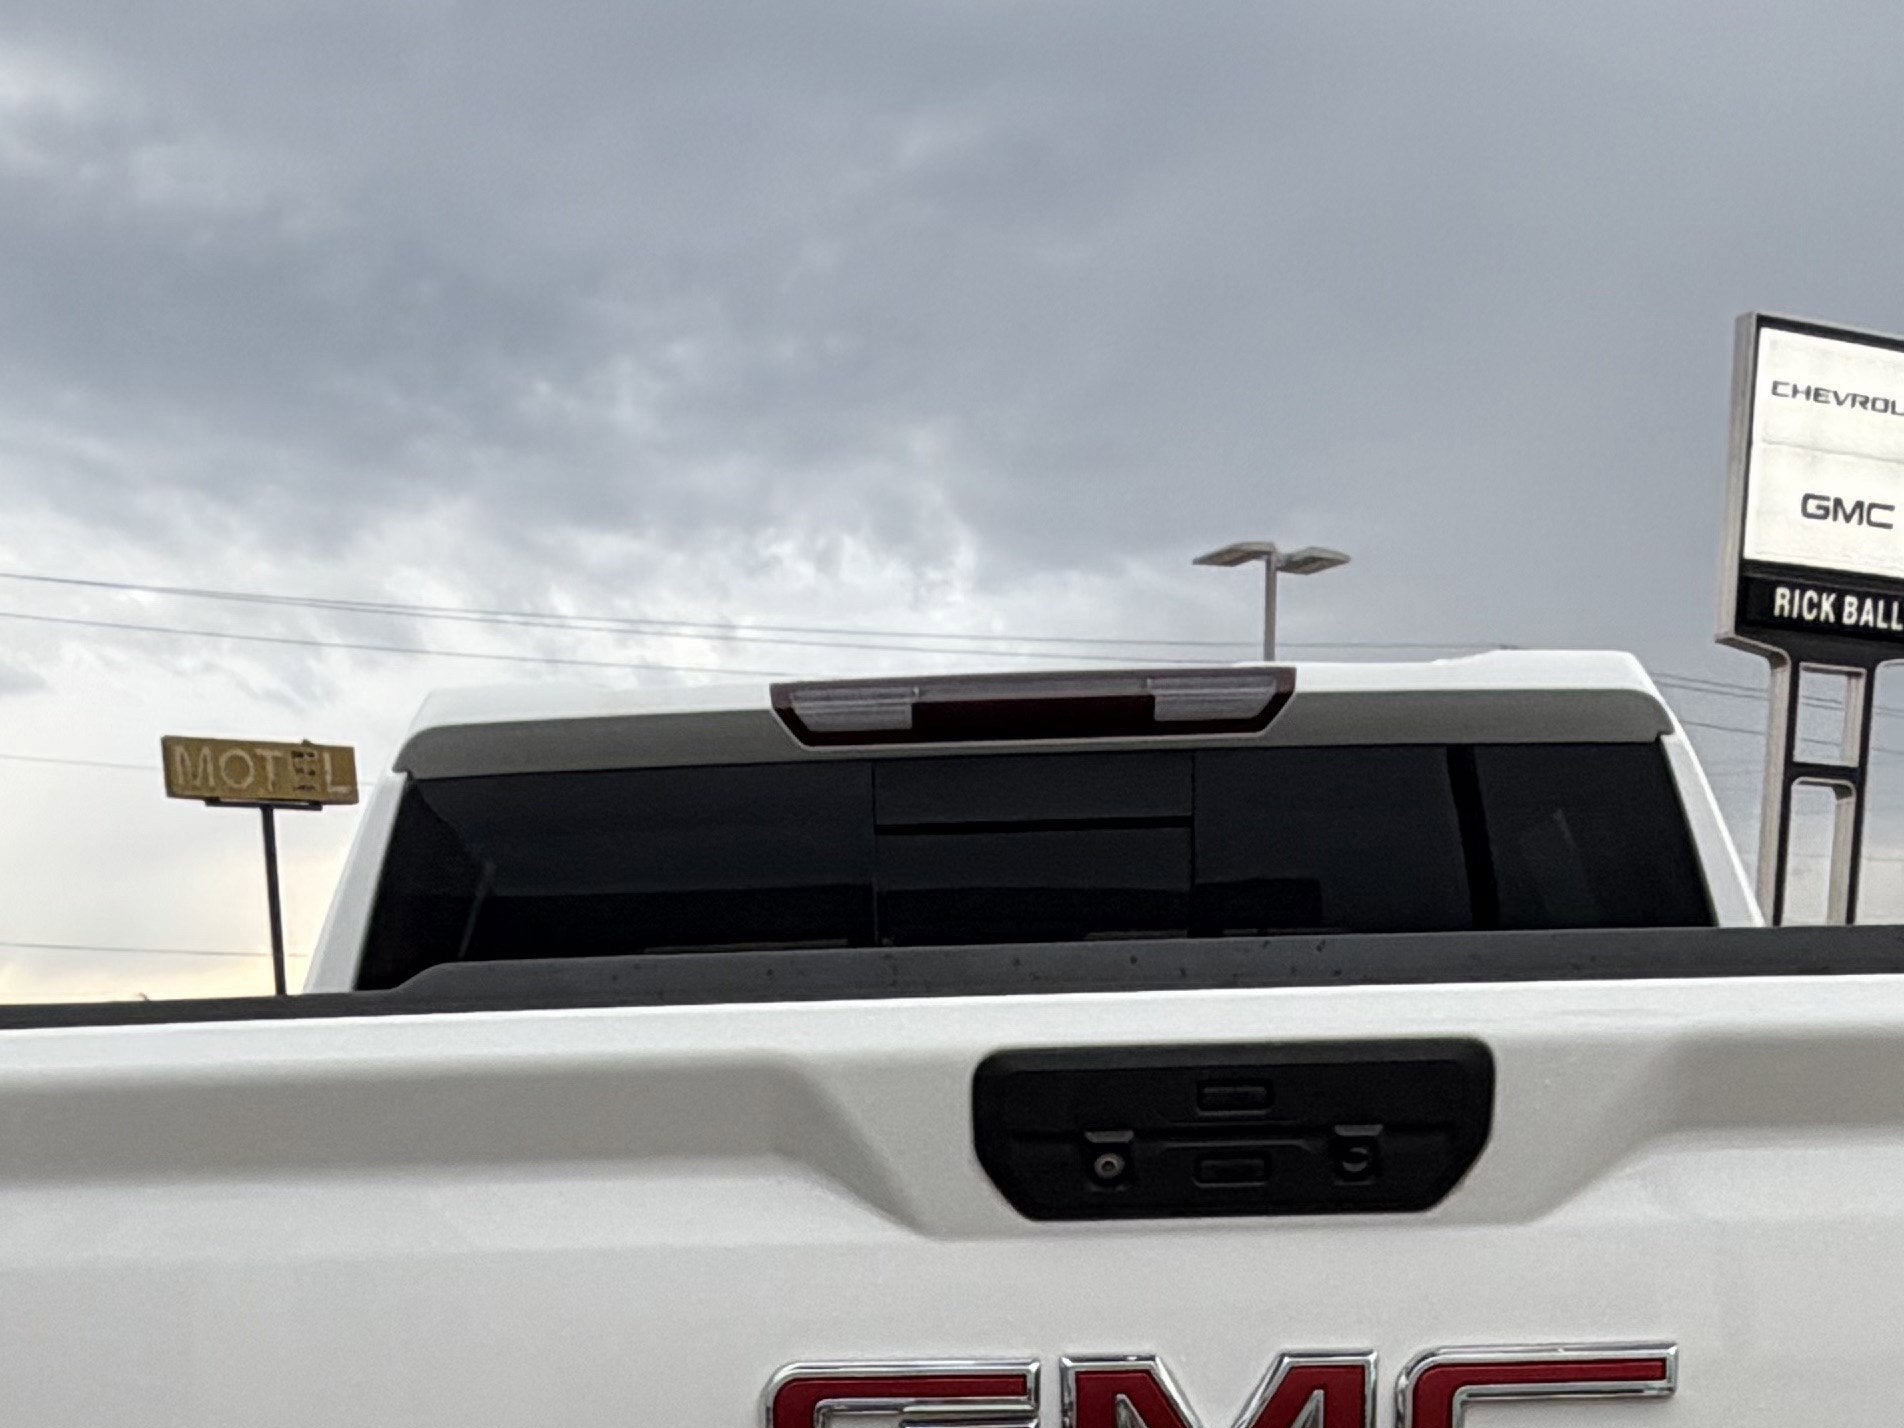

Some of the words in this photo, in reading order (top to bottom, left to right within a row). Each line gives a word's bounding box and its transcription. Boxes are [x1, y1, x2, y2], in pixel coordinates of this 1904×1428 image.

[1801, 492, 1896, 531] GMC
[1773, 586, 1837, 624] RICK
[1842, 594, 1904, 632] BALL
[173, 744, 351, 794] MOTEL
